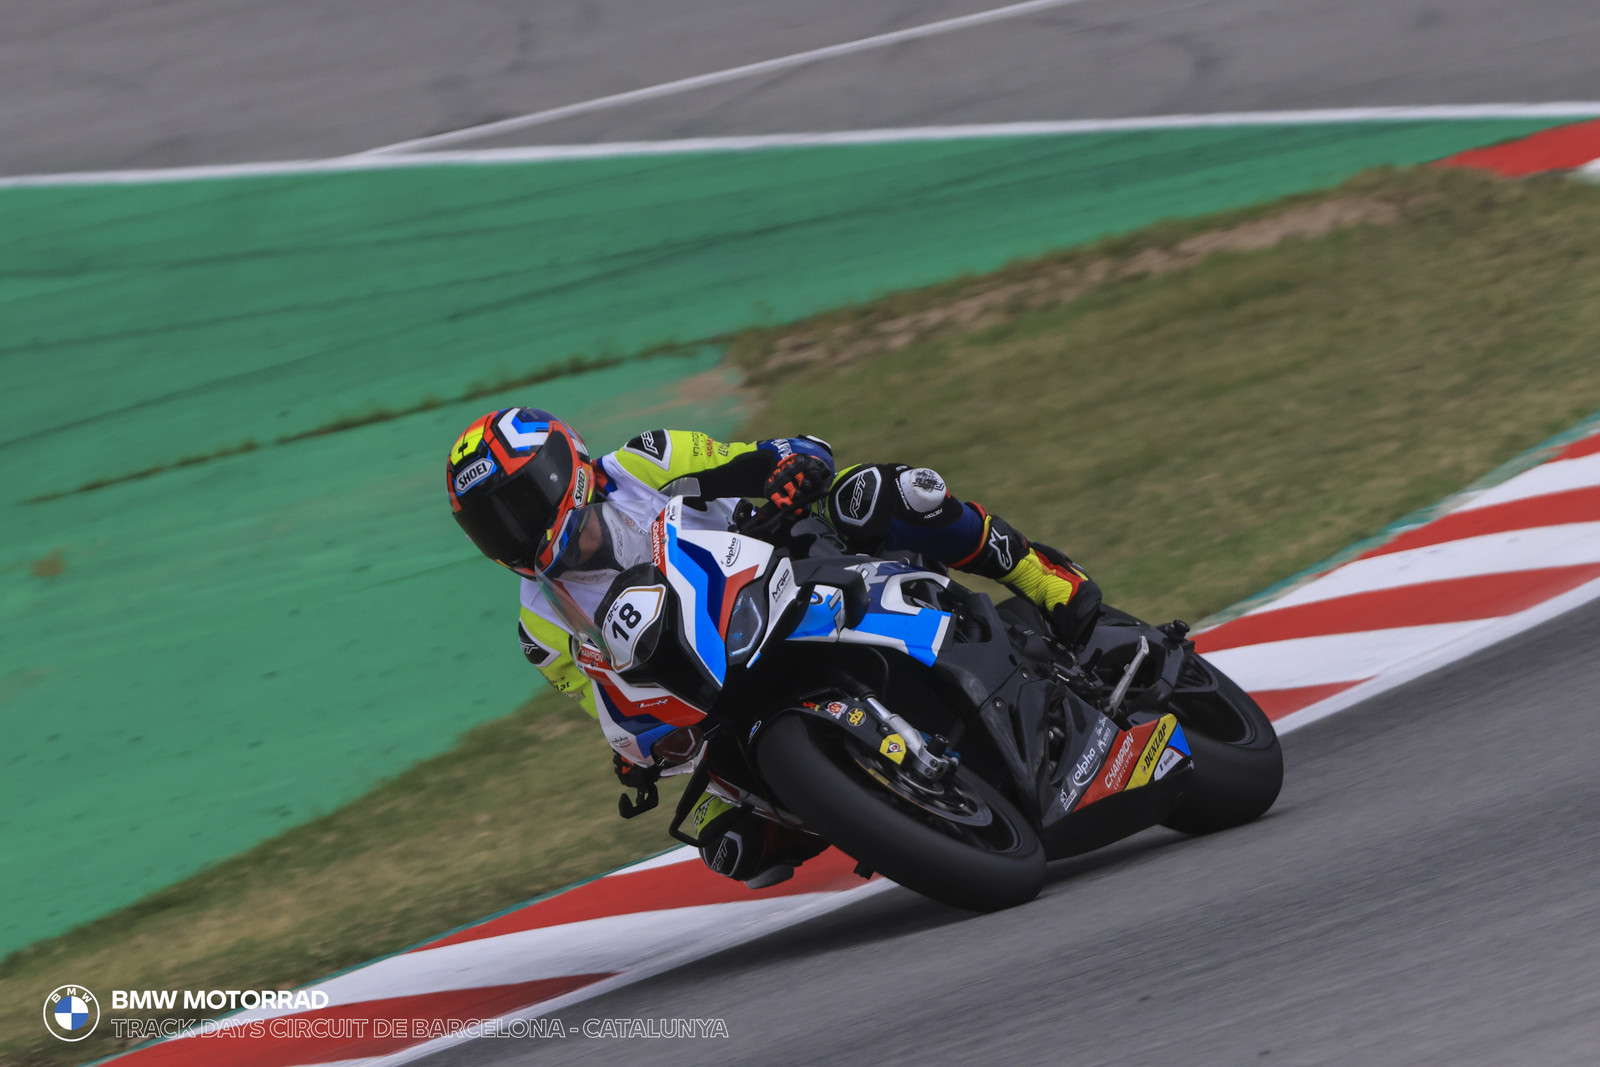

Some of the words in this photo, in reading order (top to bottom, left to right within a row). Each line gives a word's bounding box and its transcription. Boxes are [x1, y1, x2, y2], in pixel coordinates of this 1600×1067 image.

[458, 462, 488, 489] SHOEI
[575, 470, 586, 502] SHOEI
[849, 473, 866, 518] RST
[725, 537, 737, 565] alpha
[772, 568, 790, 600] MRP
[612, 603, 642, 642] 18
[1104, 732, 1134, 789] CHAMPION
[1144, 723, 1167, 768] DUNLOP
[1074, 747, 1096, 781] alpha
